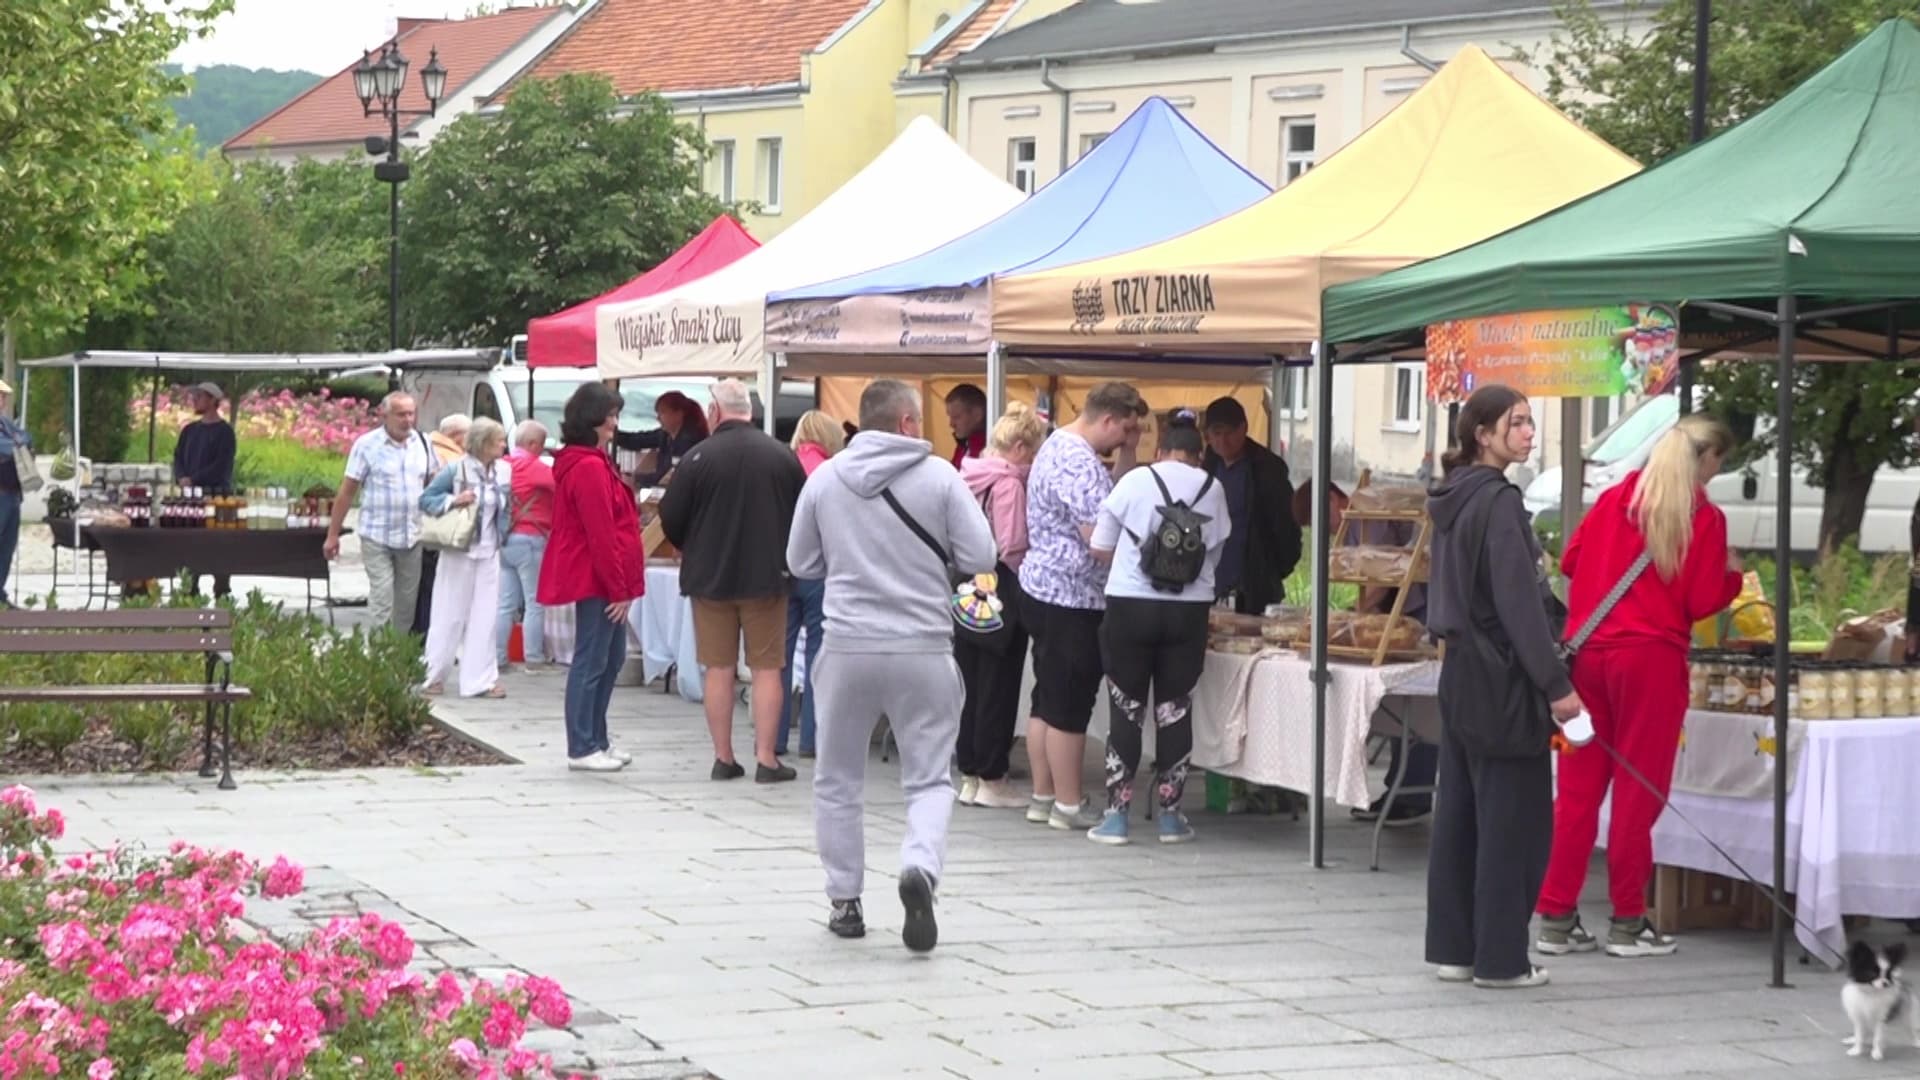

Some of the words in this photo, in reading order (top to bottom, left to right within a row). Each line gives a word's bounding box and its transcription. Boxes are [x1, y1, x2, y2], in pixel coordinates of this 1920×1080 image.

[1112, 275, 1151, 315] TRZY
[1155, 273, 1215, 313] ZIARNA
[615, 312, 666, 360] Wiejskie
[669, 307, 710, 344] Smaki
[713, 305, 743, 355] Ewy
[1530, 311, 1617, 340] naturalne
